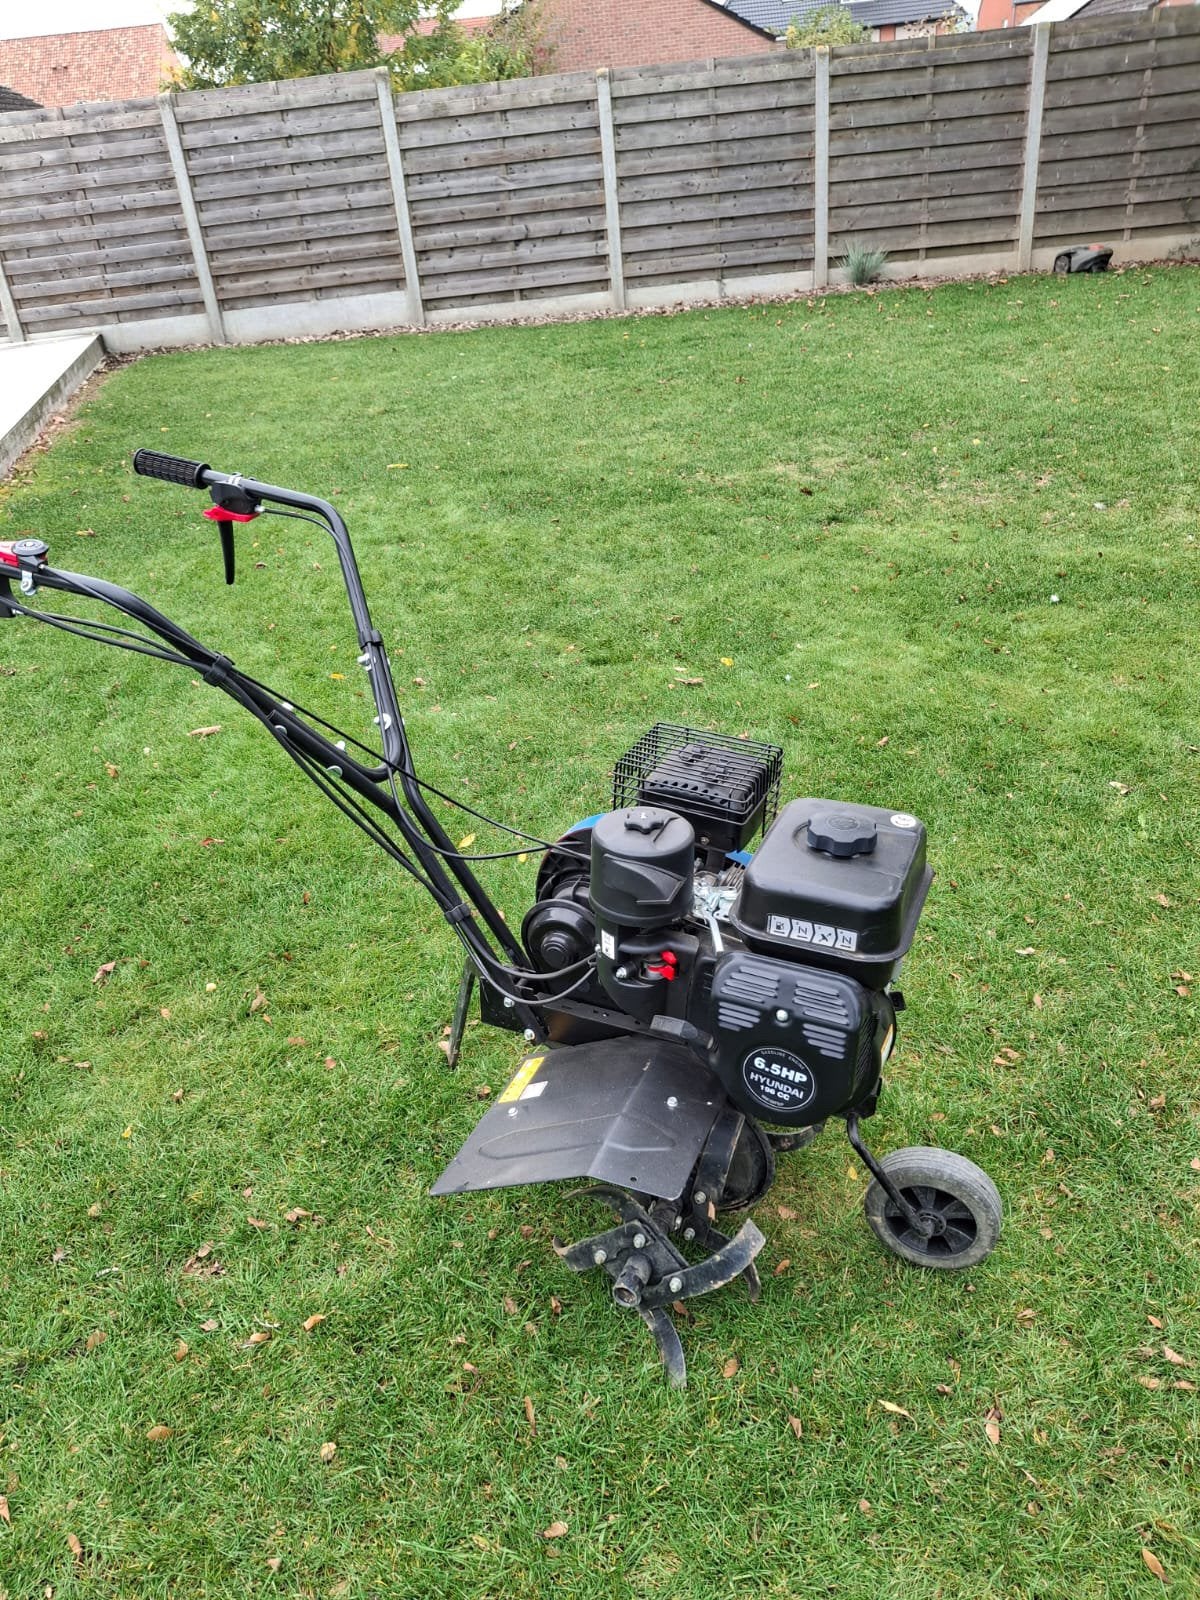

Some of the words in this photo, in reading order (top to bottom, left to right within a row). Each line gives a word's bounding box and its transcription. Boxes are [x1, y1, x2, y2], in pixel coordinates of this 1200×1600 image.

[754, 1057, 808, 1083] 6.5HP
[750, 1072, 804, 1099] HYUNDAI
[776, 1091, 790, 1101] CC
